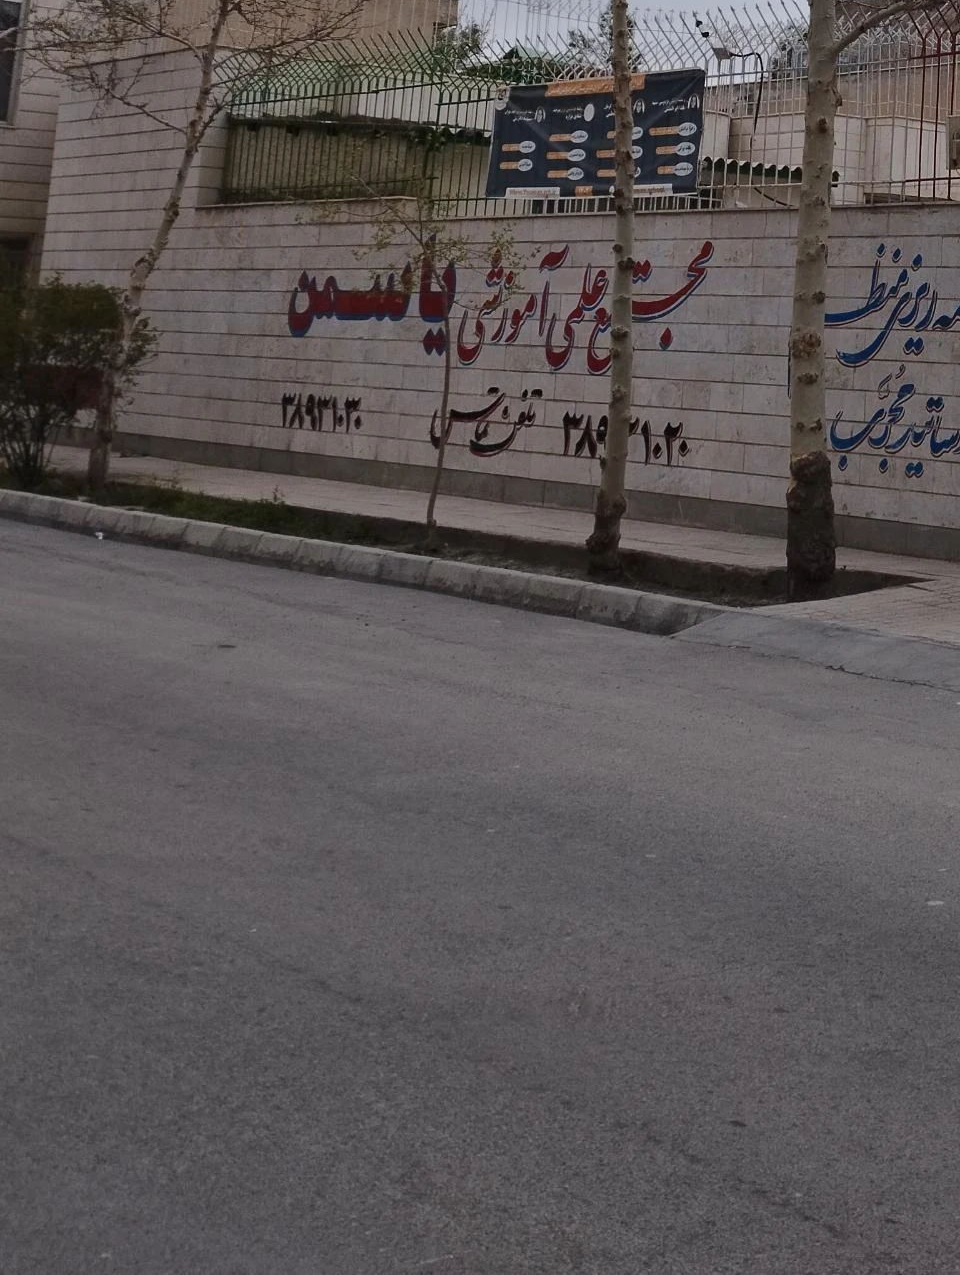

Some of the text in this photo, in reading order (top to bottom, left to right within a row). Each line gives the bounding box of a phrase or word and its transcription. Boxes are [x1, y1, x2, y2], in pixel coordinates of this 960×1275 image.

[288, 233, 456, 356] یاسمن
[457, 244, 569, 366] آموزشی
[545, 262, 610, 372] علمی
[836, 253, 937, 366] ریزی
[281, 392, 362, 434] ۳۸۹۳۱۰۳۰
[469, 388, 544, 458] تلفن
